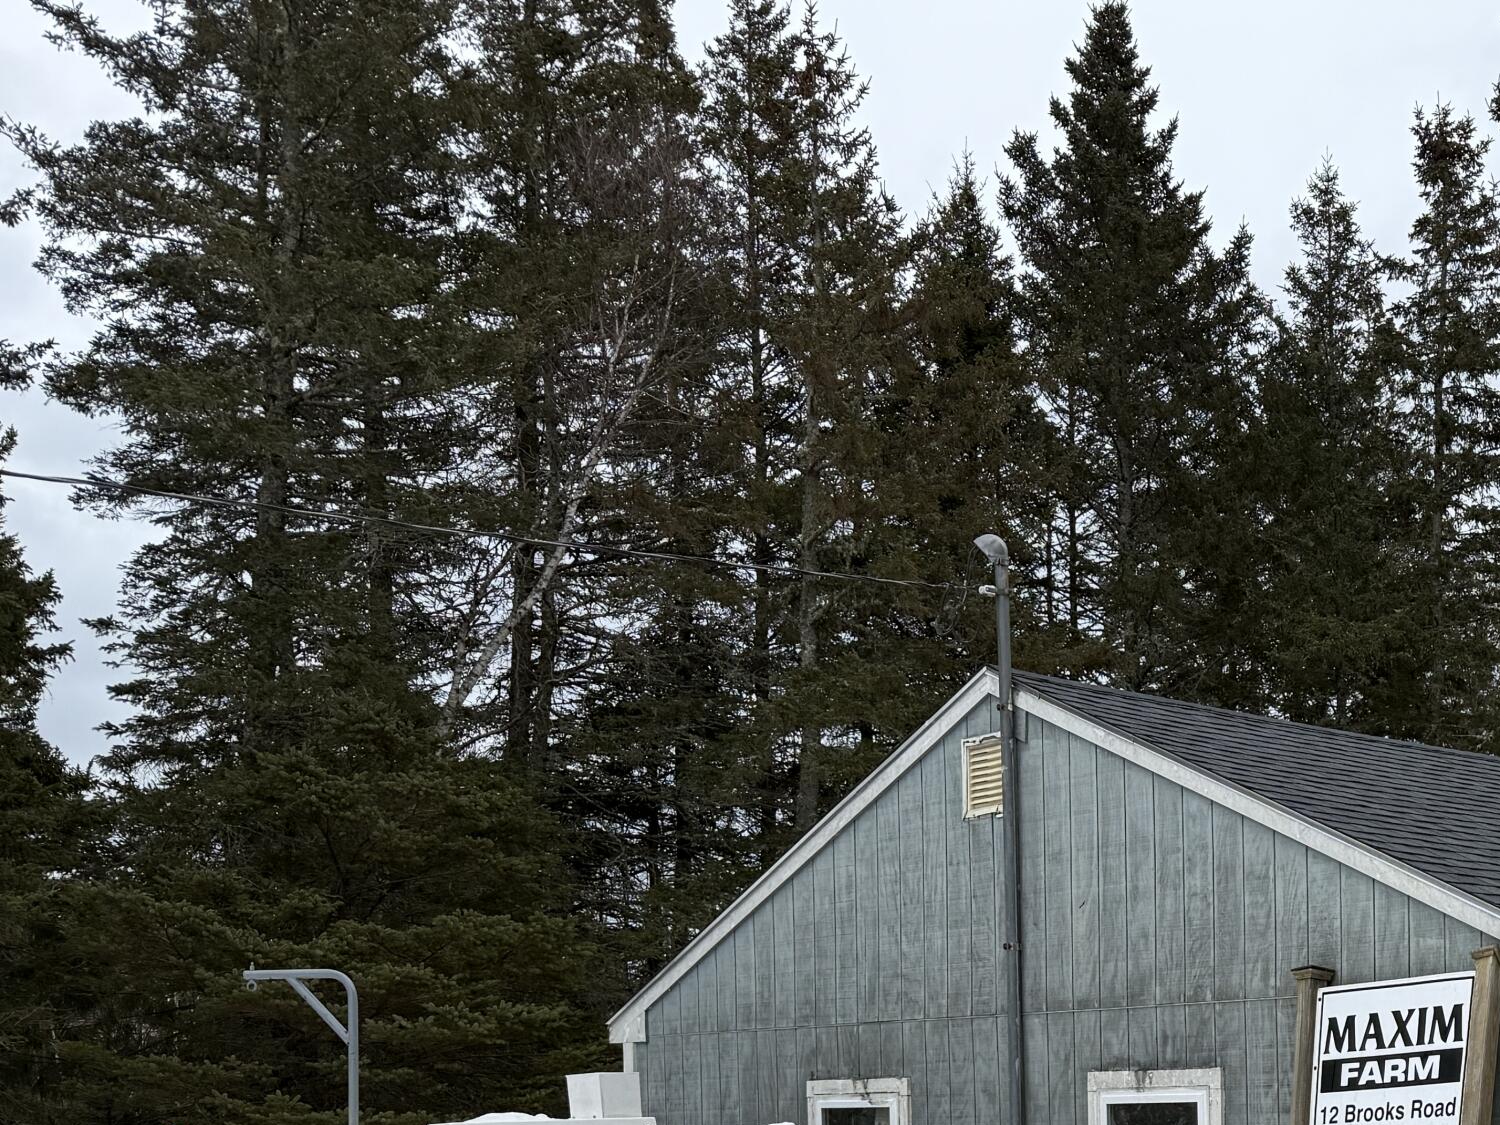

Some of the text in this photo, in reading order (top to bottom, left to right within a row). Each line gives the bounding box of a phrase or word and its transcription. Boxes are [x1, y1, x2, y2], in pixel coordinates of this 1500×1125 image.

[1323, 1003, 1465, 1055] MAXIM
[1340, 1054, 1441, 1087] FARM
[1320, 1097, 1457, 1125] 12 Brooks Road
